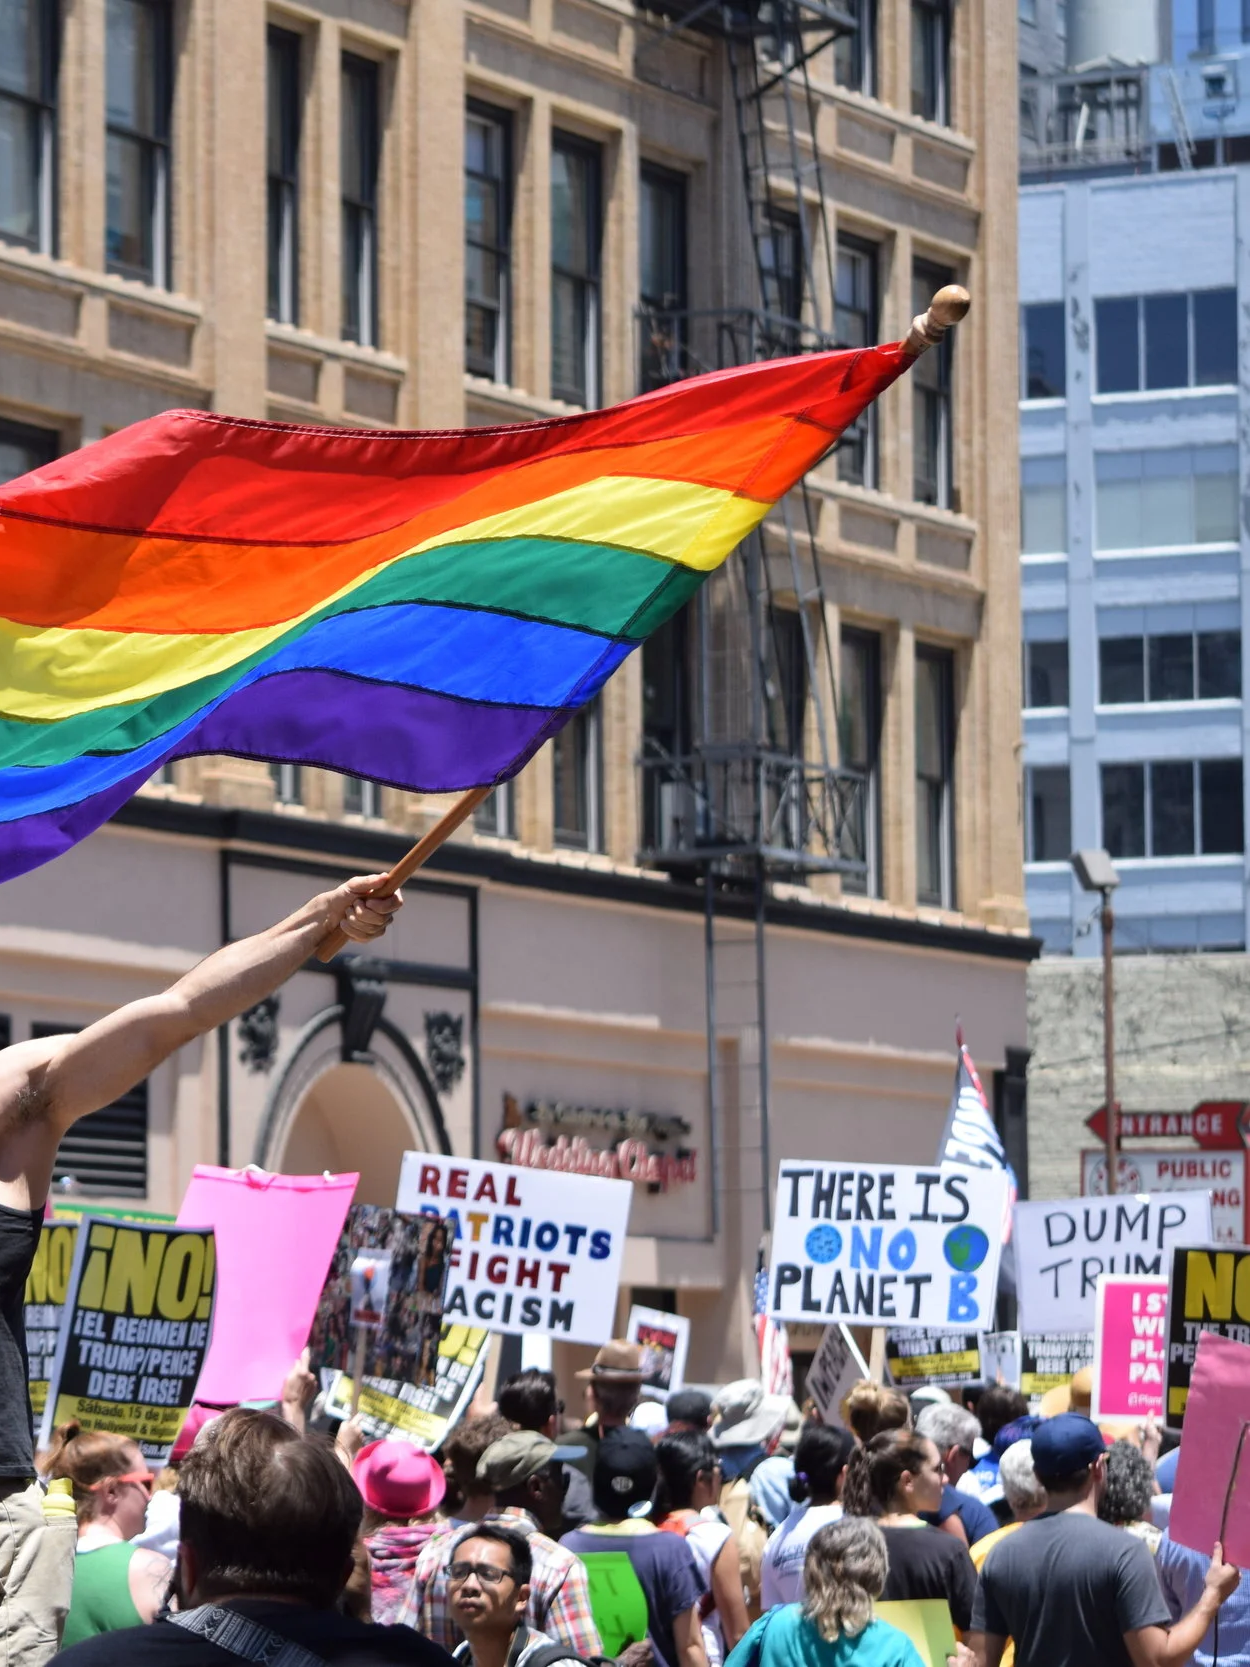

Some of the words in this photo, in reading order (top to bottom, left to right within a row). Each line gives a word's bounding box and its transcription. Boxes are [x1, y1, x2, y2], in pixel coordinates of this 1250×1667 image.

[1117, 1113, 1224, 1136] NTRANCE
[418, 1164, 522, 1207] REAL
[1157, 1159, 1232, 1179] PUBLIC
[782, 1168, 897, 1222] THERE
[910, 1173, 970, 1223] IS
[1044, 1203, 1187, 1249] DUMP
[849, 1225, 918, 1271] NO
[77, 1224, 217, 1321] ¡NO!
[773, 1262, 932, 1319] PLANET
[947, 1272, 980, 1322] B
[73, 1310, 106, 1338] ¡EL
[112, 1314, 188, 1347] REGIMEN
[188, 1320, 207, 1348] DE
[443, 1285, 575, 1332] ACISM
[78, 1340, 198, 1377] TRUMP/PENCE
[87, 1371, 136, 1402] DEBE
[138, 1375, 183, 1405] IRSE!
[129, 1405, 142, 1419] 15
